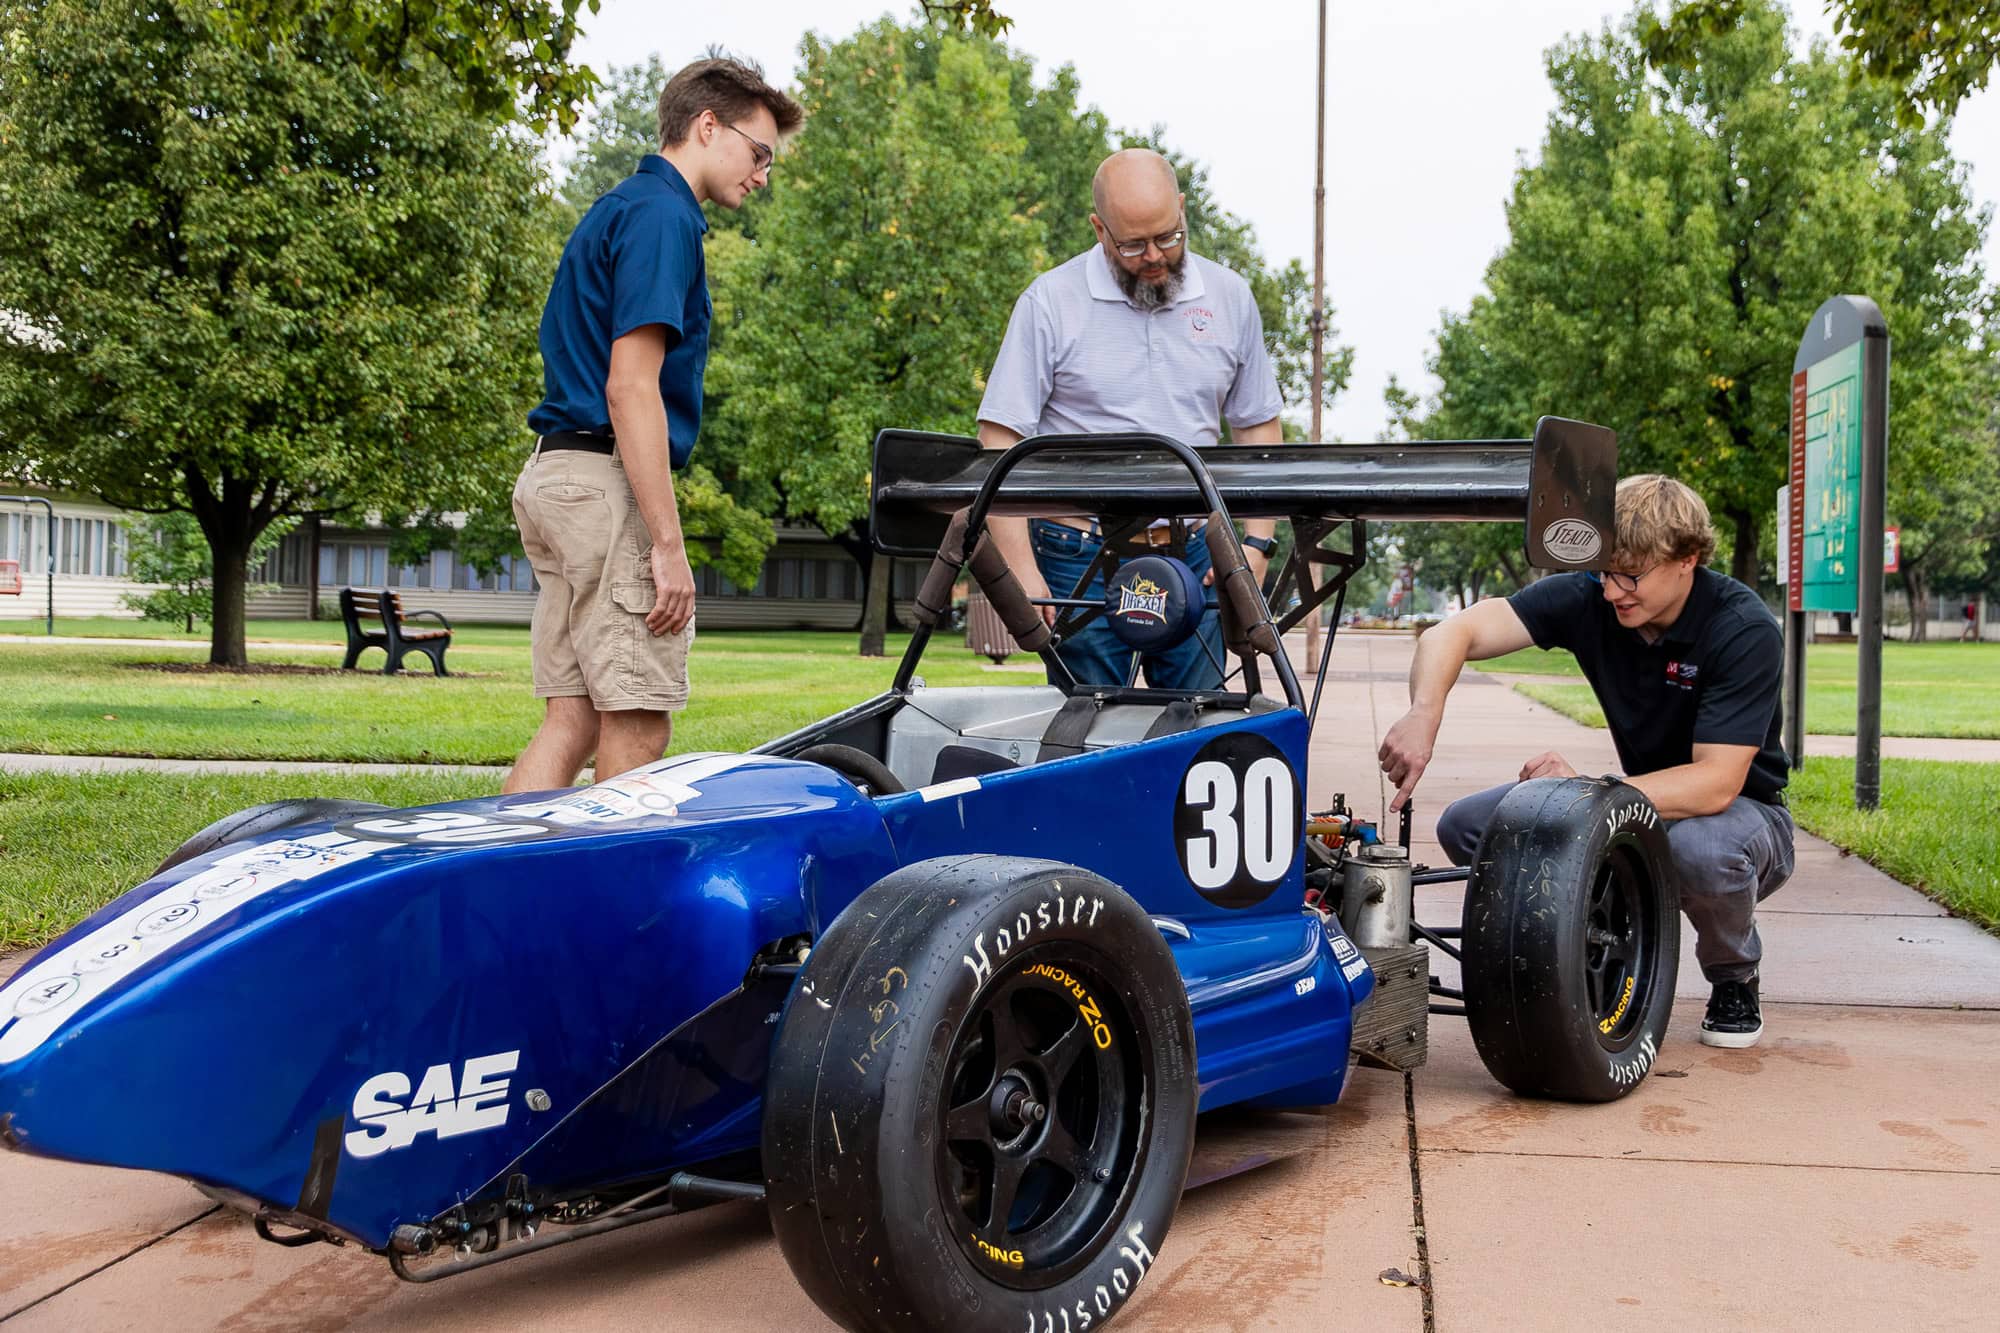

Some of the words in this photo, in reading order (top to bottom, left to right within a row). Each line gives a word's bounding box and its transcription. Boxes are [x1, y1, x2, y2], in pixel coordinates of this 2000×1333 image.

[1544, 523, 1597, 547] STEALTH
[353, 812, 549, 841] 30
[1185, 757, 1294, 888] 30
[963, 880, 1104, 1002] Hoosier
[1609, 976, 1634, 1026] RACING
[345, 1050, 520, 1159] SAE
